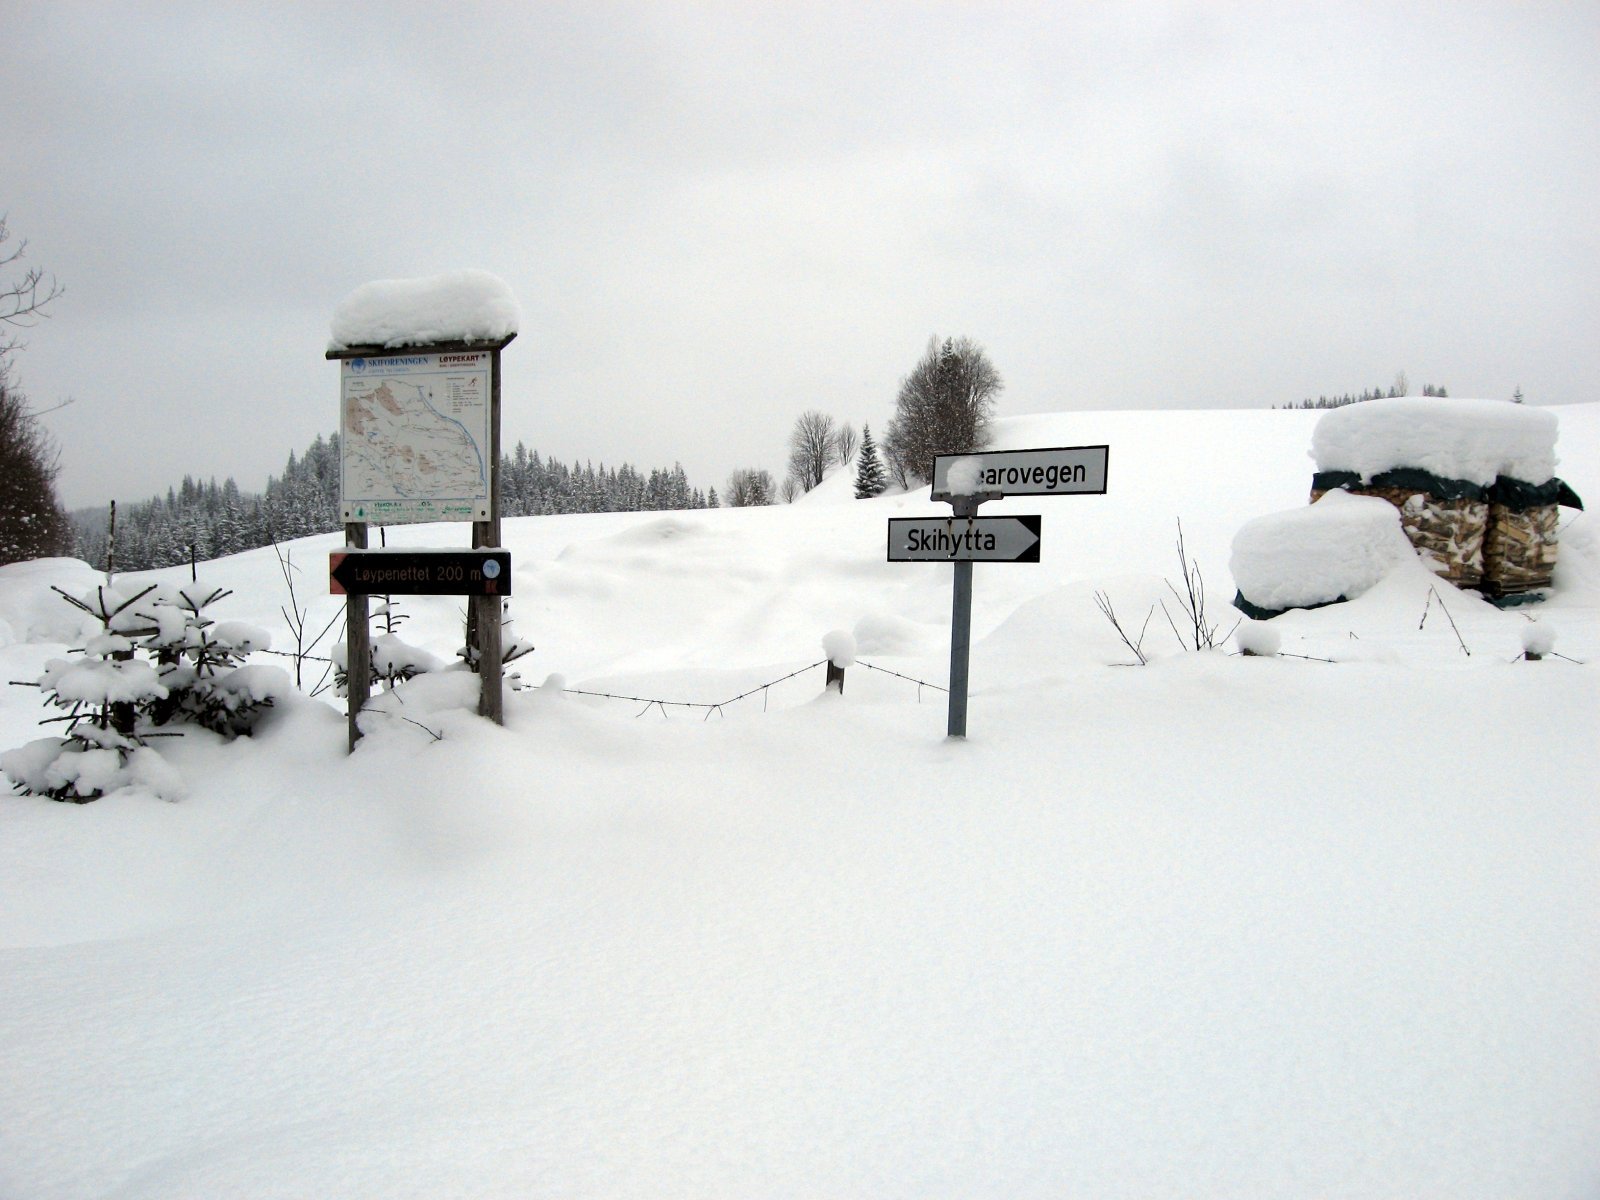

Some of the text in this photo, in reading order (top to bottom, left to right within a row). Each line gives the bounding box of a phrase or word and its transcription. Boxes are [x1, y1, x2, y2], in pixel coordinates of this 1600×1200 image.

[368, 356, 429, 367] SKIFORENINGEN
[439, 354, 480, 363] LØYPEKART
[907, 528, 996, 557] Skihytta
[355, 566, 482, 584] Løypenettet 200 m
